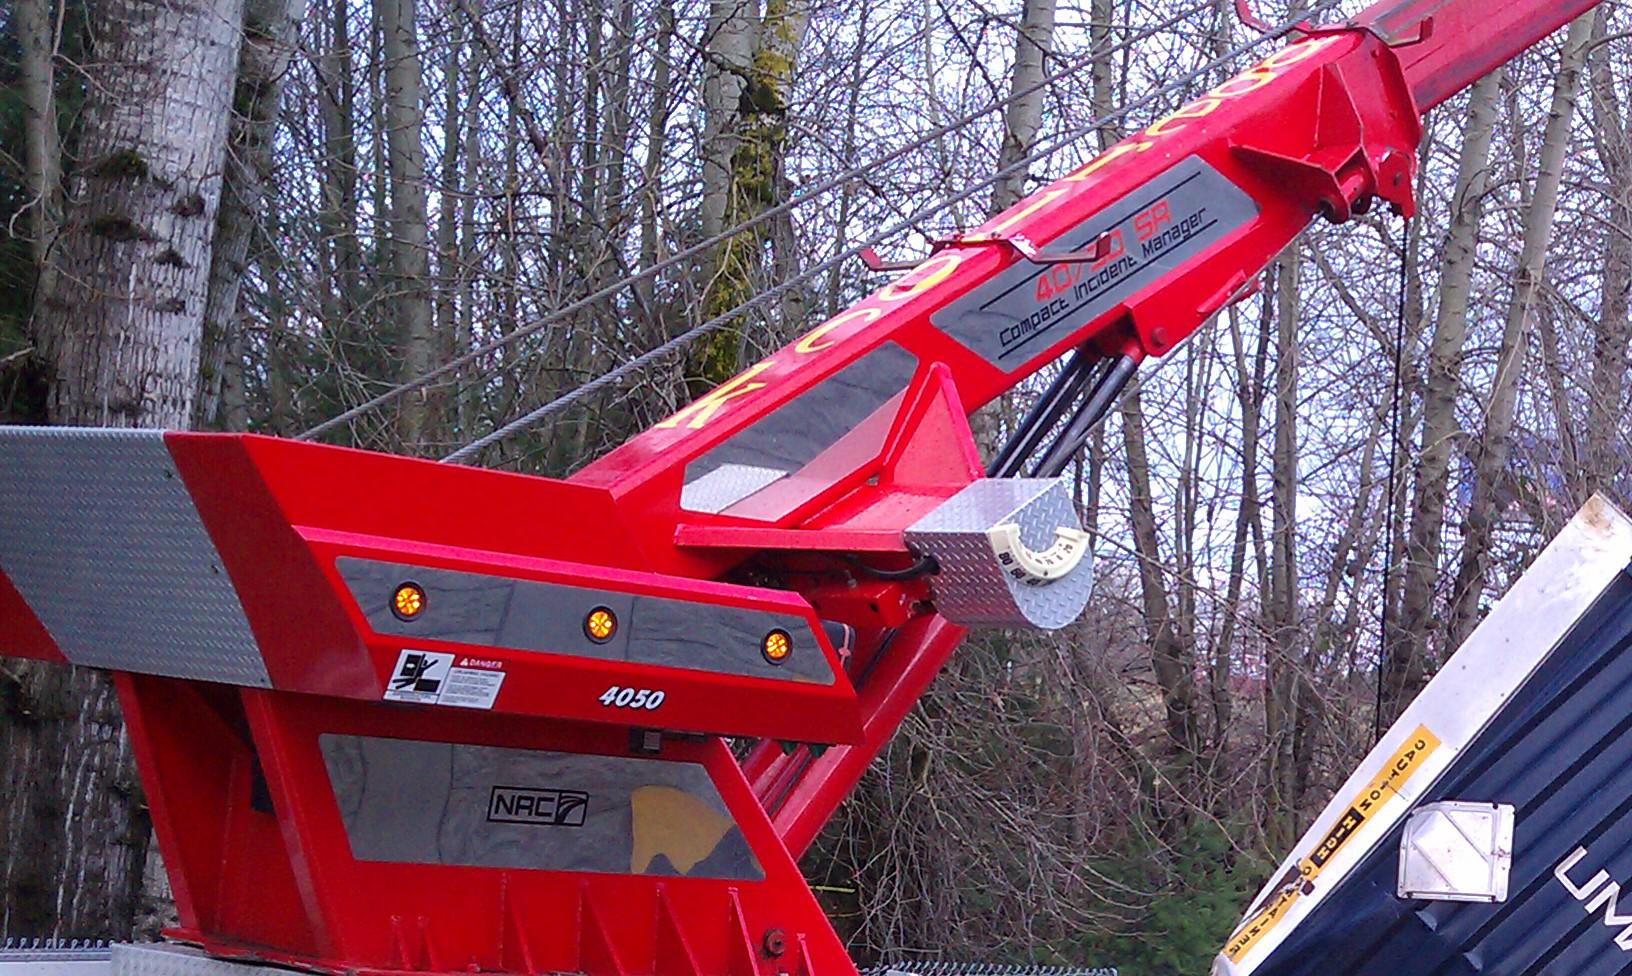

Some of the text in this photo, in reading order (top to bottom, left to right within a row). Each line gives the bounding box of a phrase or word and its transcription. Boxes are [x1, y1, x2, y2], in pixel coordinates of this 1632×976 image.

[999, 207, 1207, 348] Compact Incident Manager
[469, 658, 503, 669] DANGER
[598, 686, 665, 709] 4050
[494, 794, 556, 817] NRC
